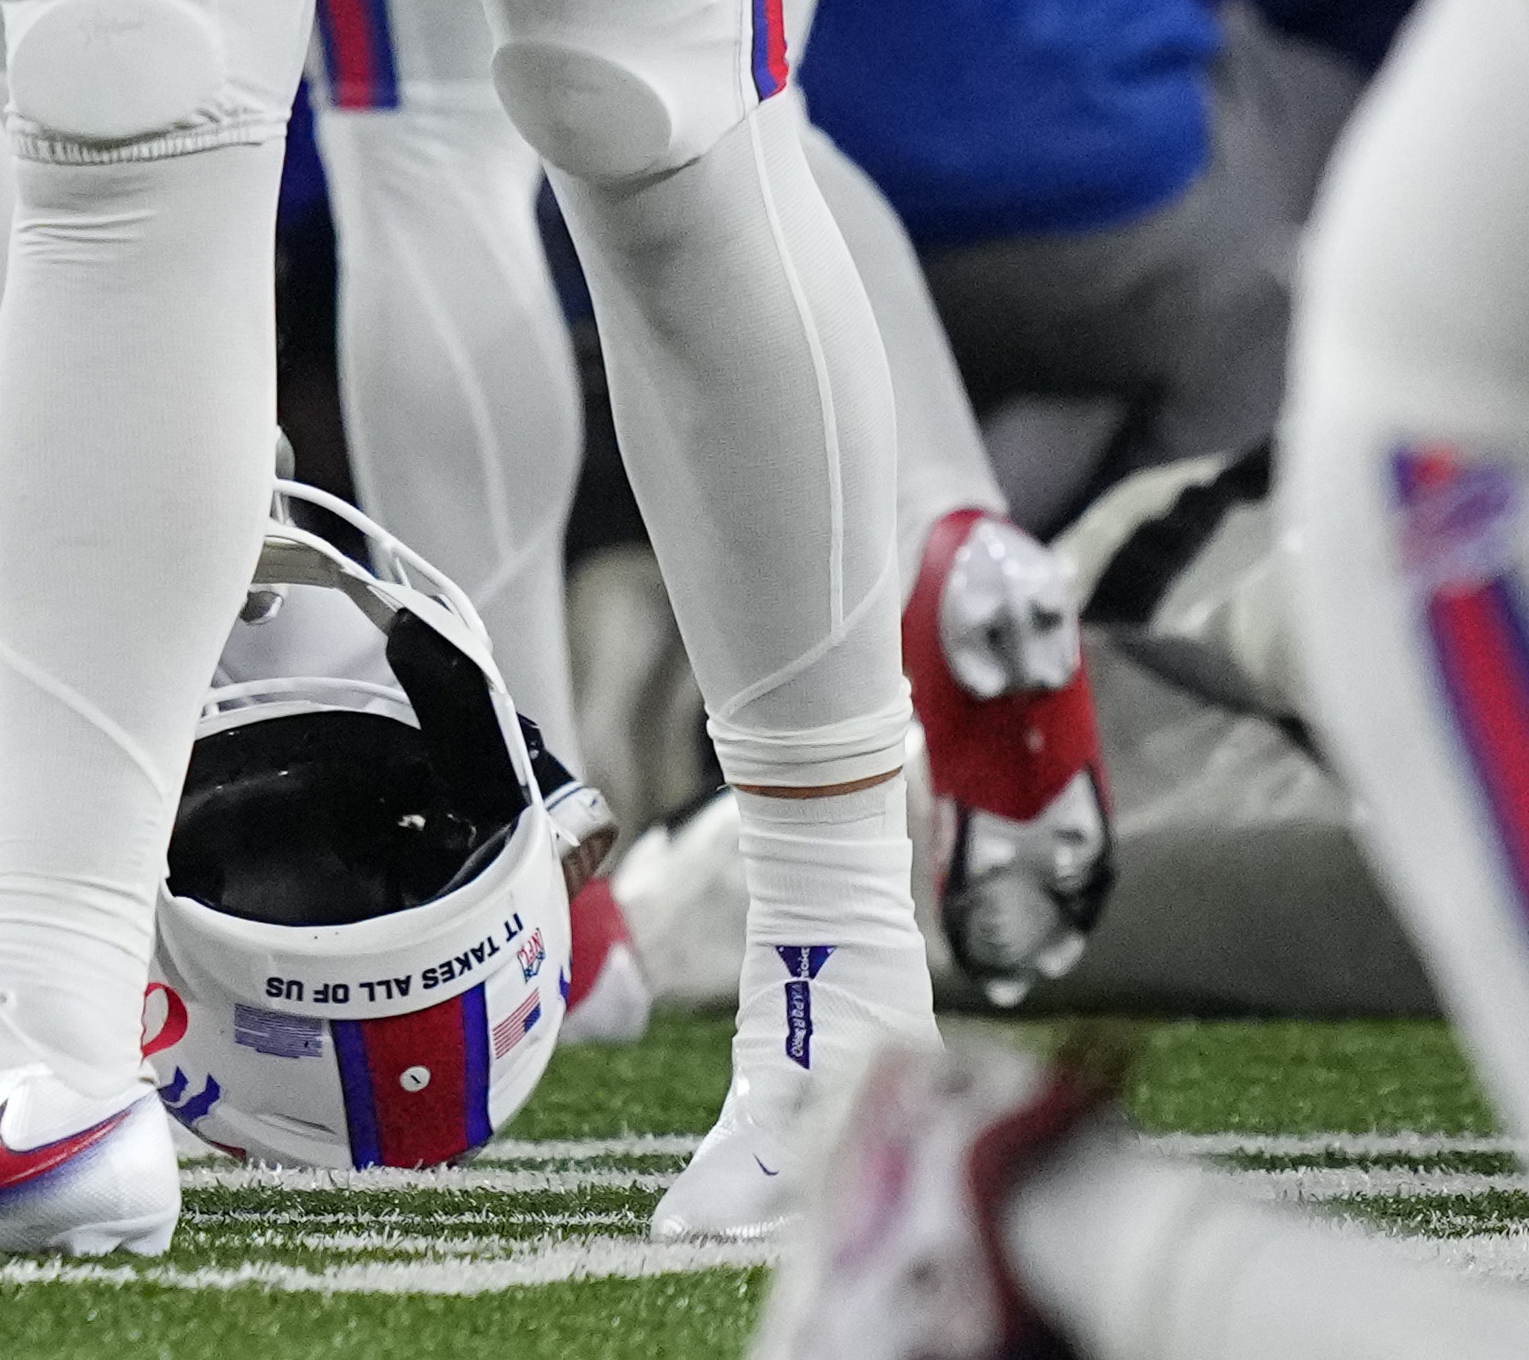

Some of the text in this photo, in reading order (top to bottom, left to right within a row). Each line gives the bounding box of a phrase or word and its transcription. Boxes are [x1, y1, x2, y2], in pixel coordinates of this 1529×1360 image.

[265, 913, 524, 1003] IT TAKES ALL OF US
